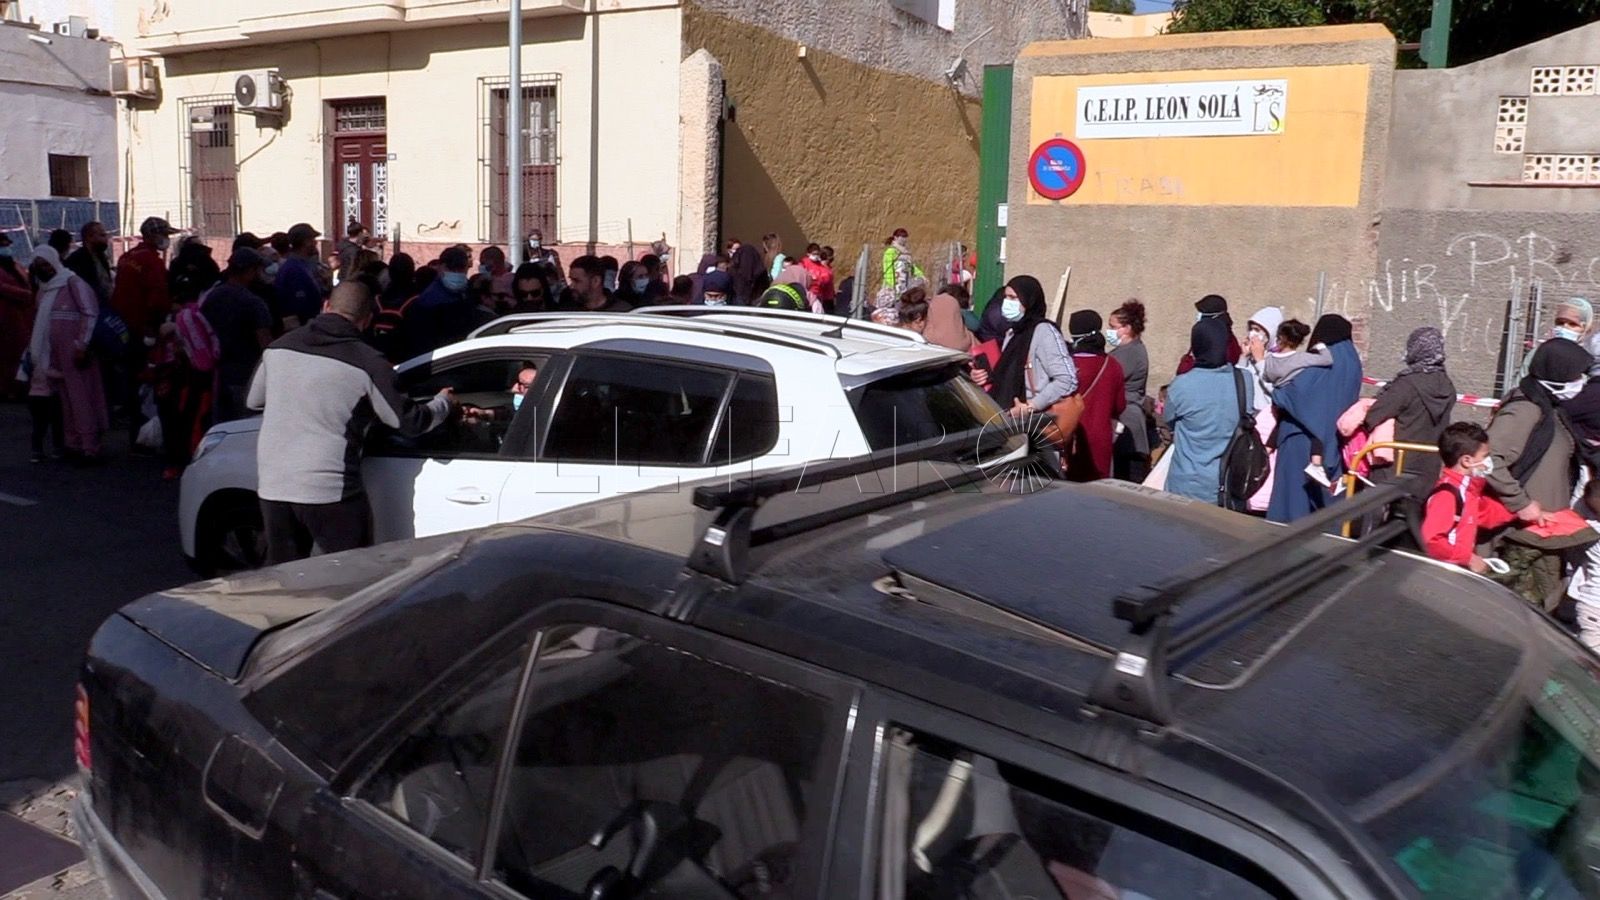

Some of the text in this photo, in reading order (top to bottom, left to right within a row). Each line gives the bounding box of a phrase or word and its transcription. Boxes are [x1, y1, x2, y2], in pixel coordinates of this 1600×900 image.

[1084, 86, 1241, 123] C.E.I.P. LEON SOLÁ
